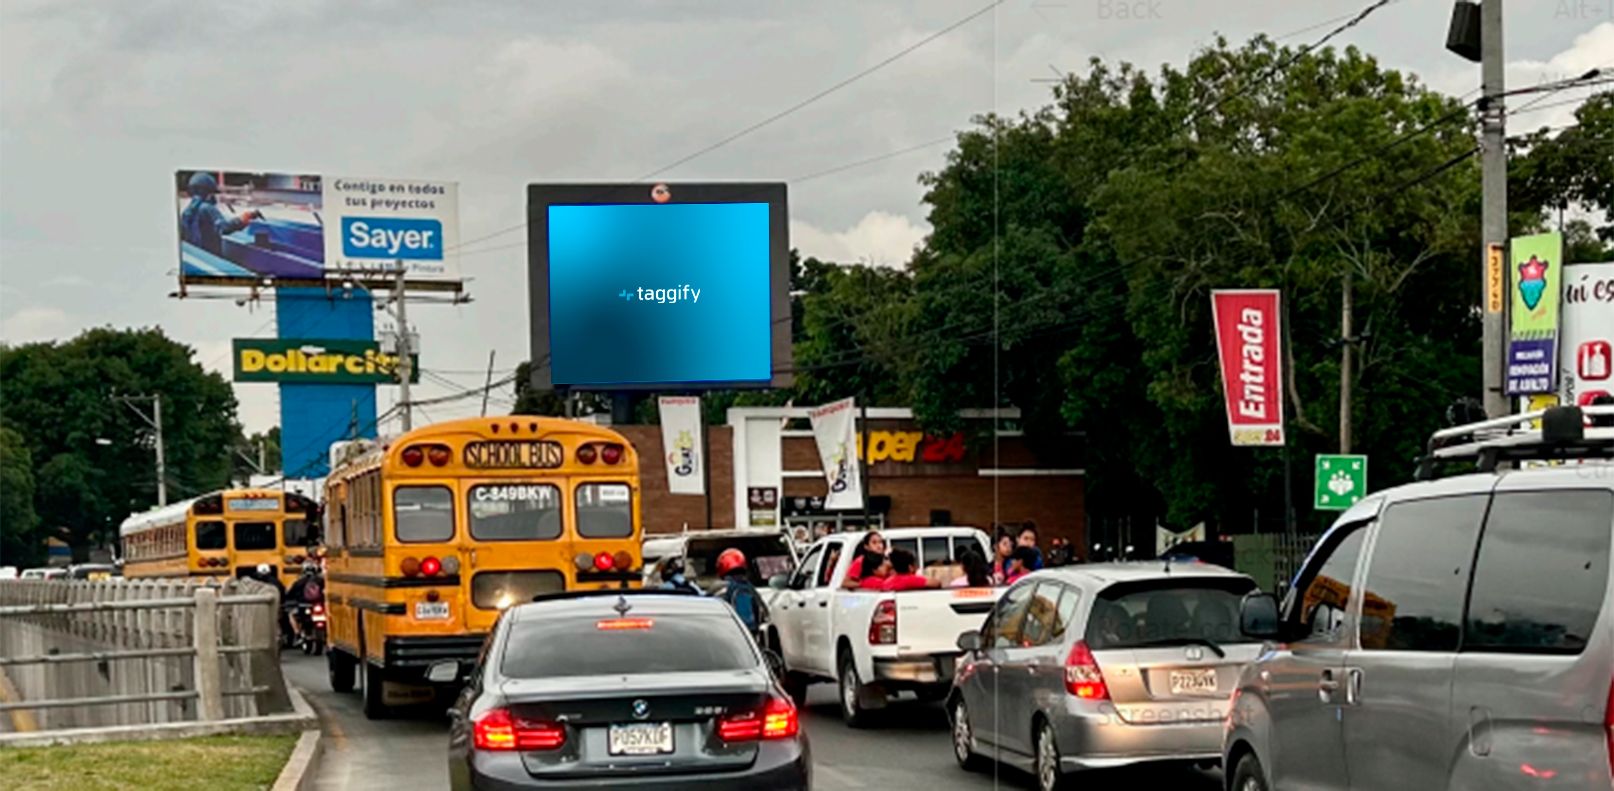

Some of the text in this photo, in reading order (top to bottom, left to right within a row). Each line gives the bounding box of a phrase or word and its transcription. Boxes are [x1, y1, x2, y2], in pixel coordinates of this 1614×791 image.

[334, 180, 445, 195] Contigo en todos
[345, 197, 435, 211] tus proyectos
[349, 221, 434, 255] Sayer
[637, 284, 701, 304] taggify
[1237, 308, 1267, 420] Entrada
[466, 442, 561, 467] SCHOOL BUS
